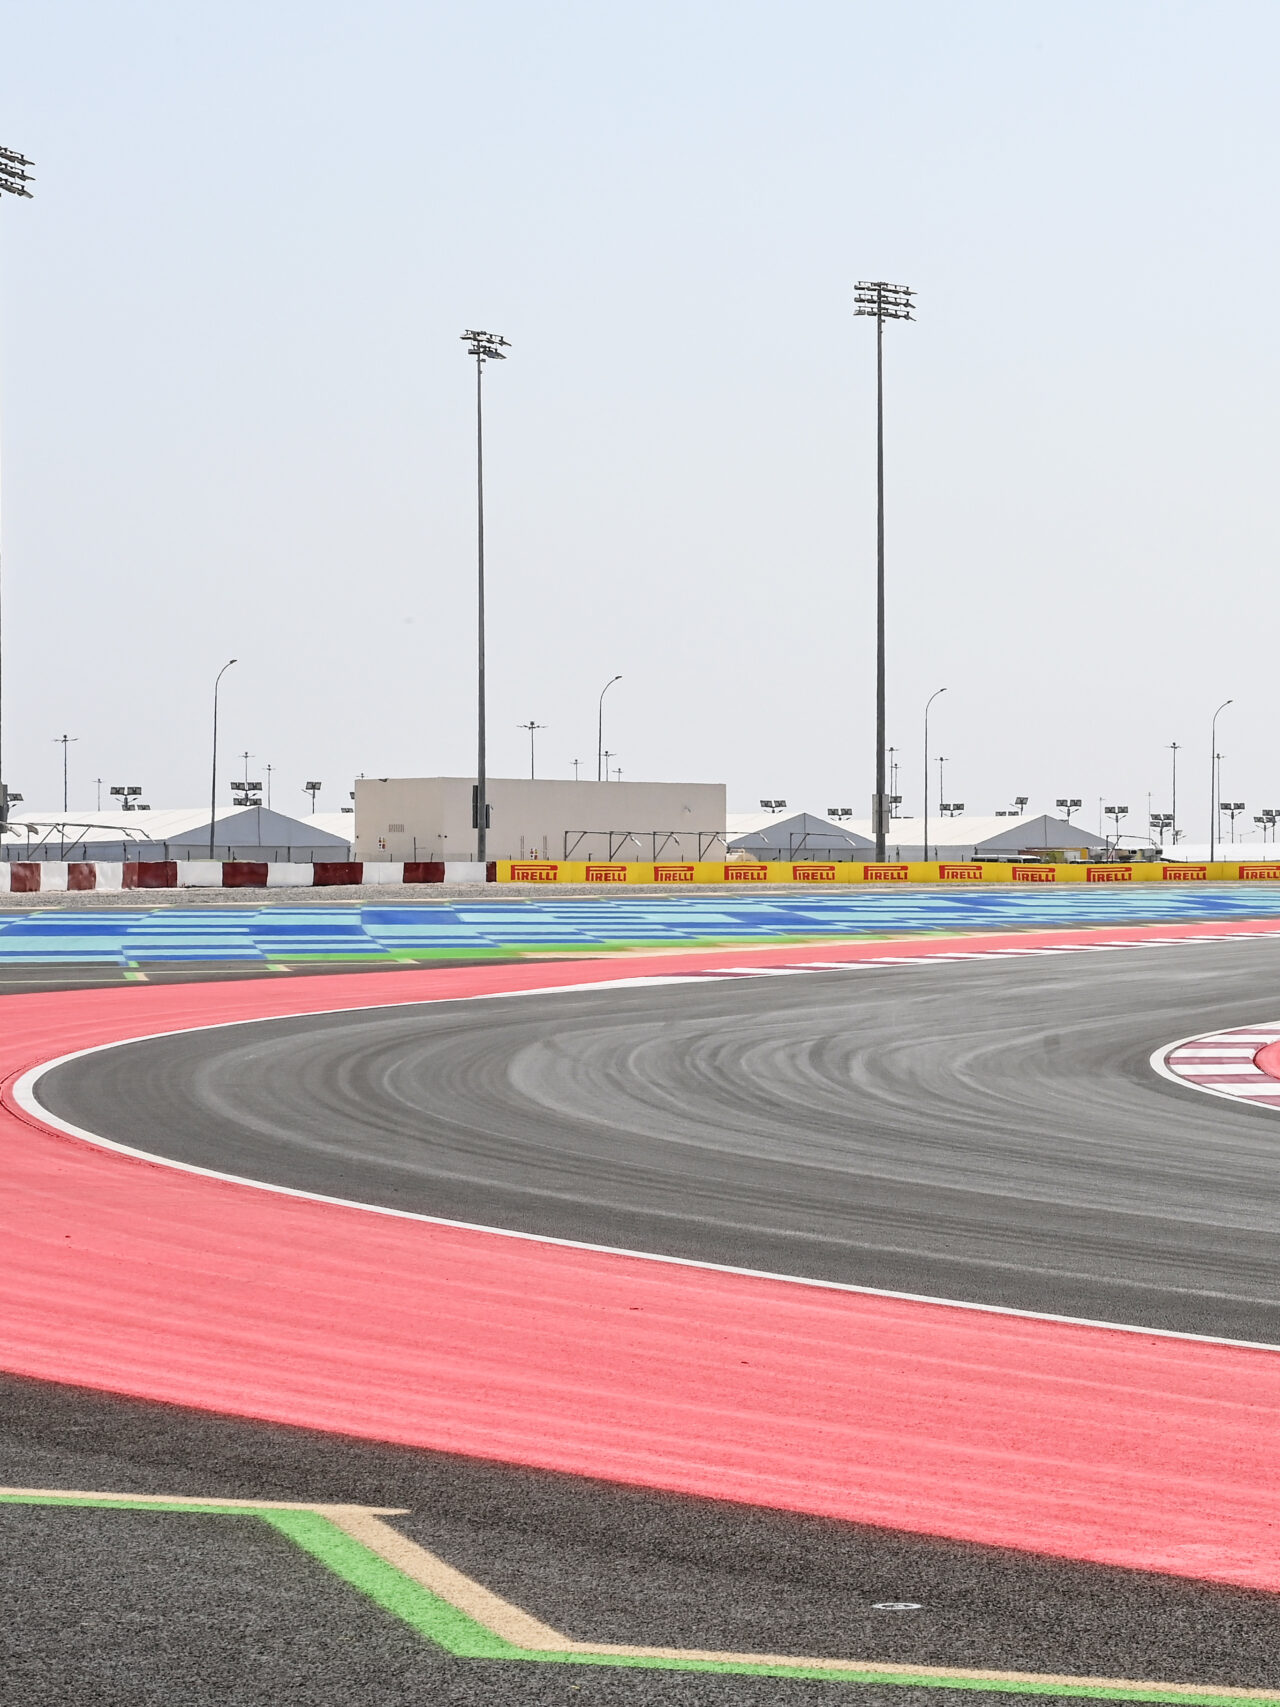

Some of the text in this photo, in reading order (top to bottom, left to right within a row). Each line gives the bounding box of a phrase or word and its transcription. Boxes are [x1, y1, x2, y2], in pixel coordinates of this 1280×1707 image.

[510, 865, 558, 881] PIRELLI
[585, 866, 627, 882] PIRELLI
[653, 866, 695, 882] PIRELLI
[724, 866, 768, 881] PIRELLI
[792, 866, 836, 881] PIRELLI
[863, 866, 909, 881] PIRELLI
[939, 865, 983, 880] PIRELLI
[1012, 867, 1056, 882] PIRELLI
[1086, 867, 1133, 882] PIRELLI
[1162, 867, 1207, 881] PIRELLI
